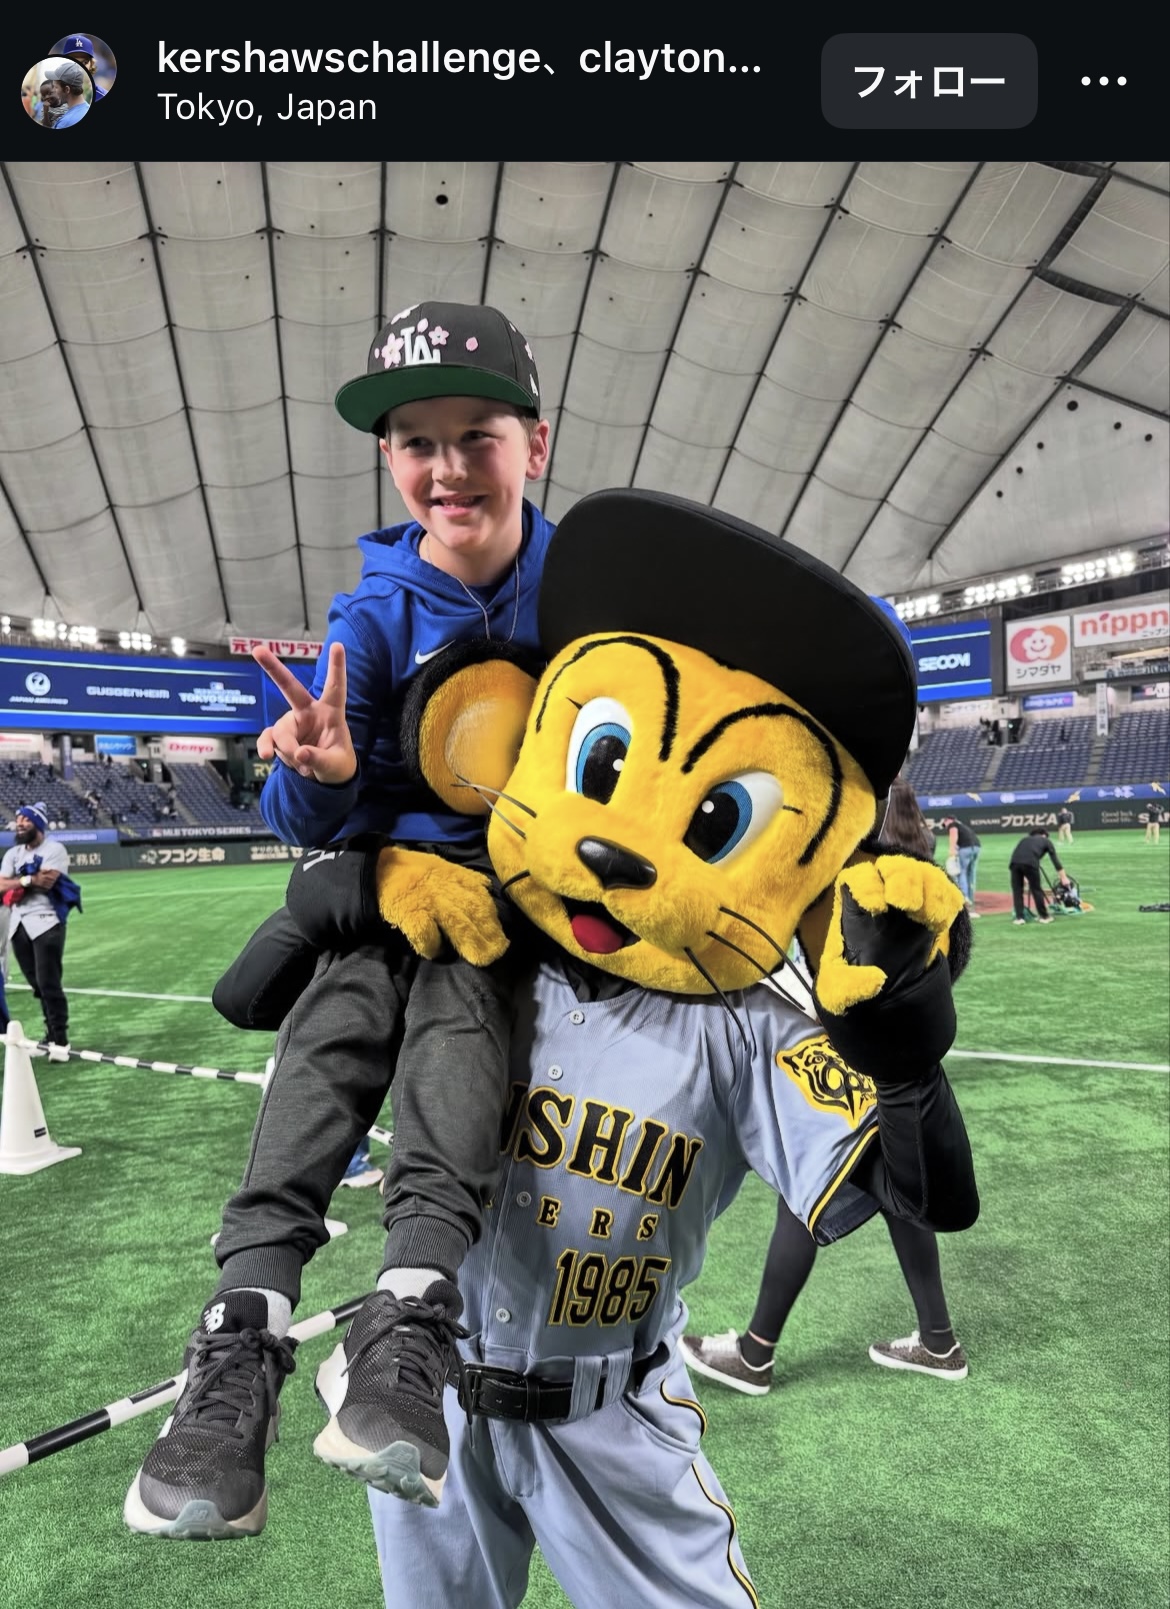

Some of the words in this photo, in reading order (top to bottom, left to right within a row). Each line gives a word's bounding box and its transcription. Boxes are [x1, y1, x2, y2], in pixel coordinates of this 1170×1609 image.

[1016, 664, 1062, 679] シマダヤ
[158, 846, 226, 865] フコク生命
[548, 1248, 671, 1328] 1985
